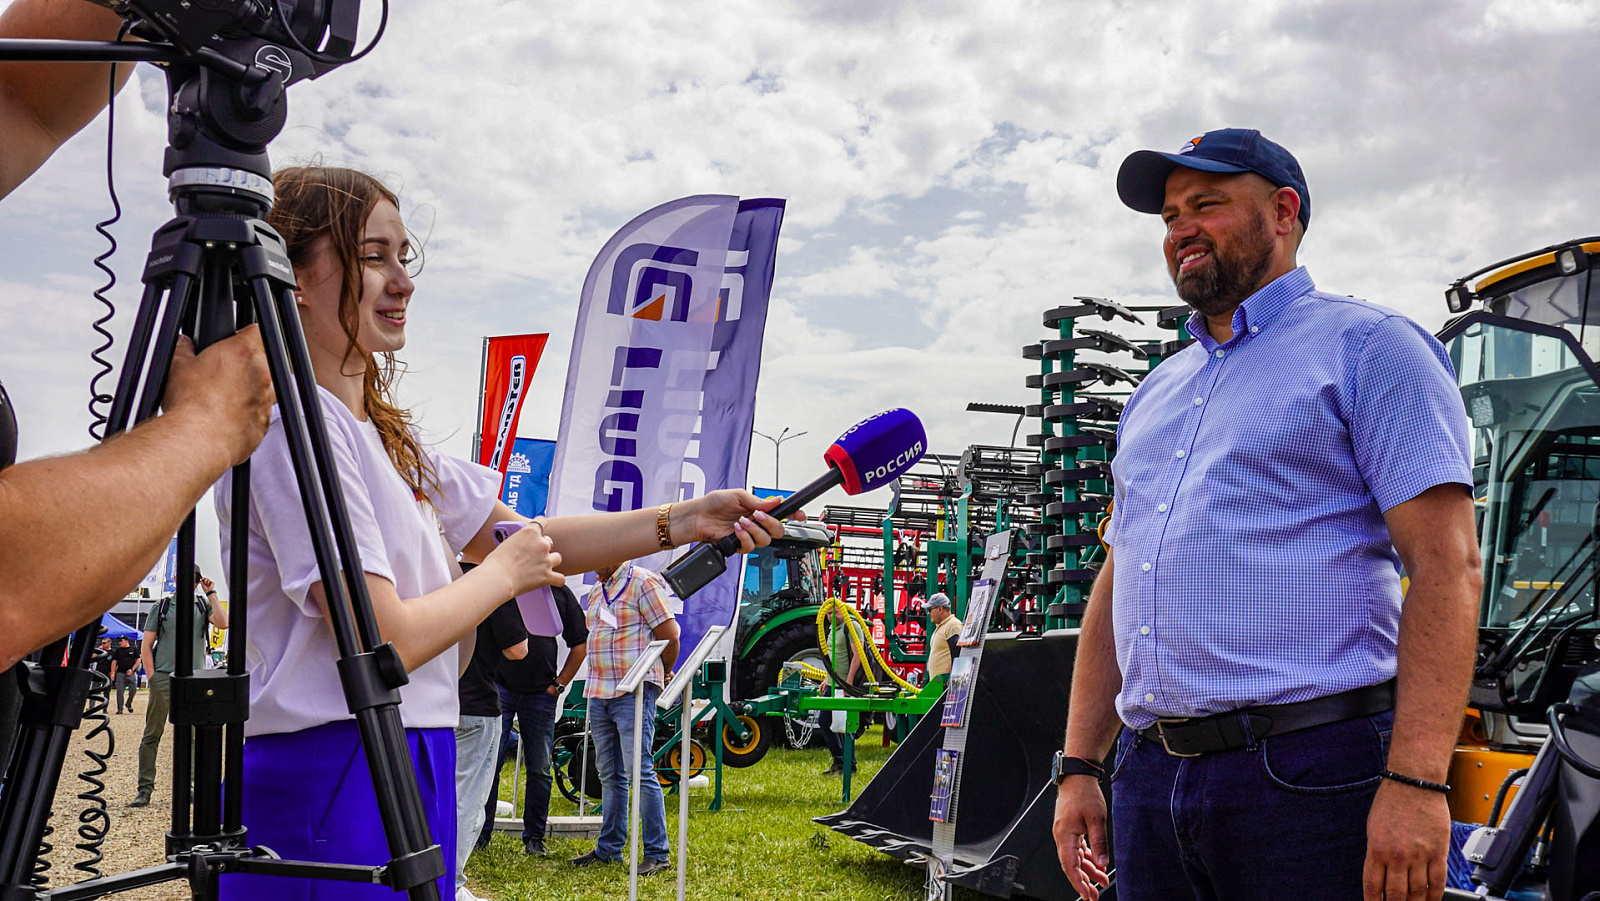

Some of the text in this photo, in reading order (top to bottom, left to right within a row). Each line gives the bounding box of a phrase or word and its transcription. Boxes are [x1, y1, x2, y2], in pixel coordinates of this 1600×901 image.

[592, 345, 663, 512] LIUG
[864, 440, 923, 484] РОССИЯ
[509, 474, 522, 489] ТД
[507, 491, 519, 511] НАБ
